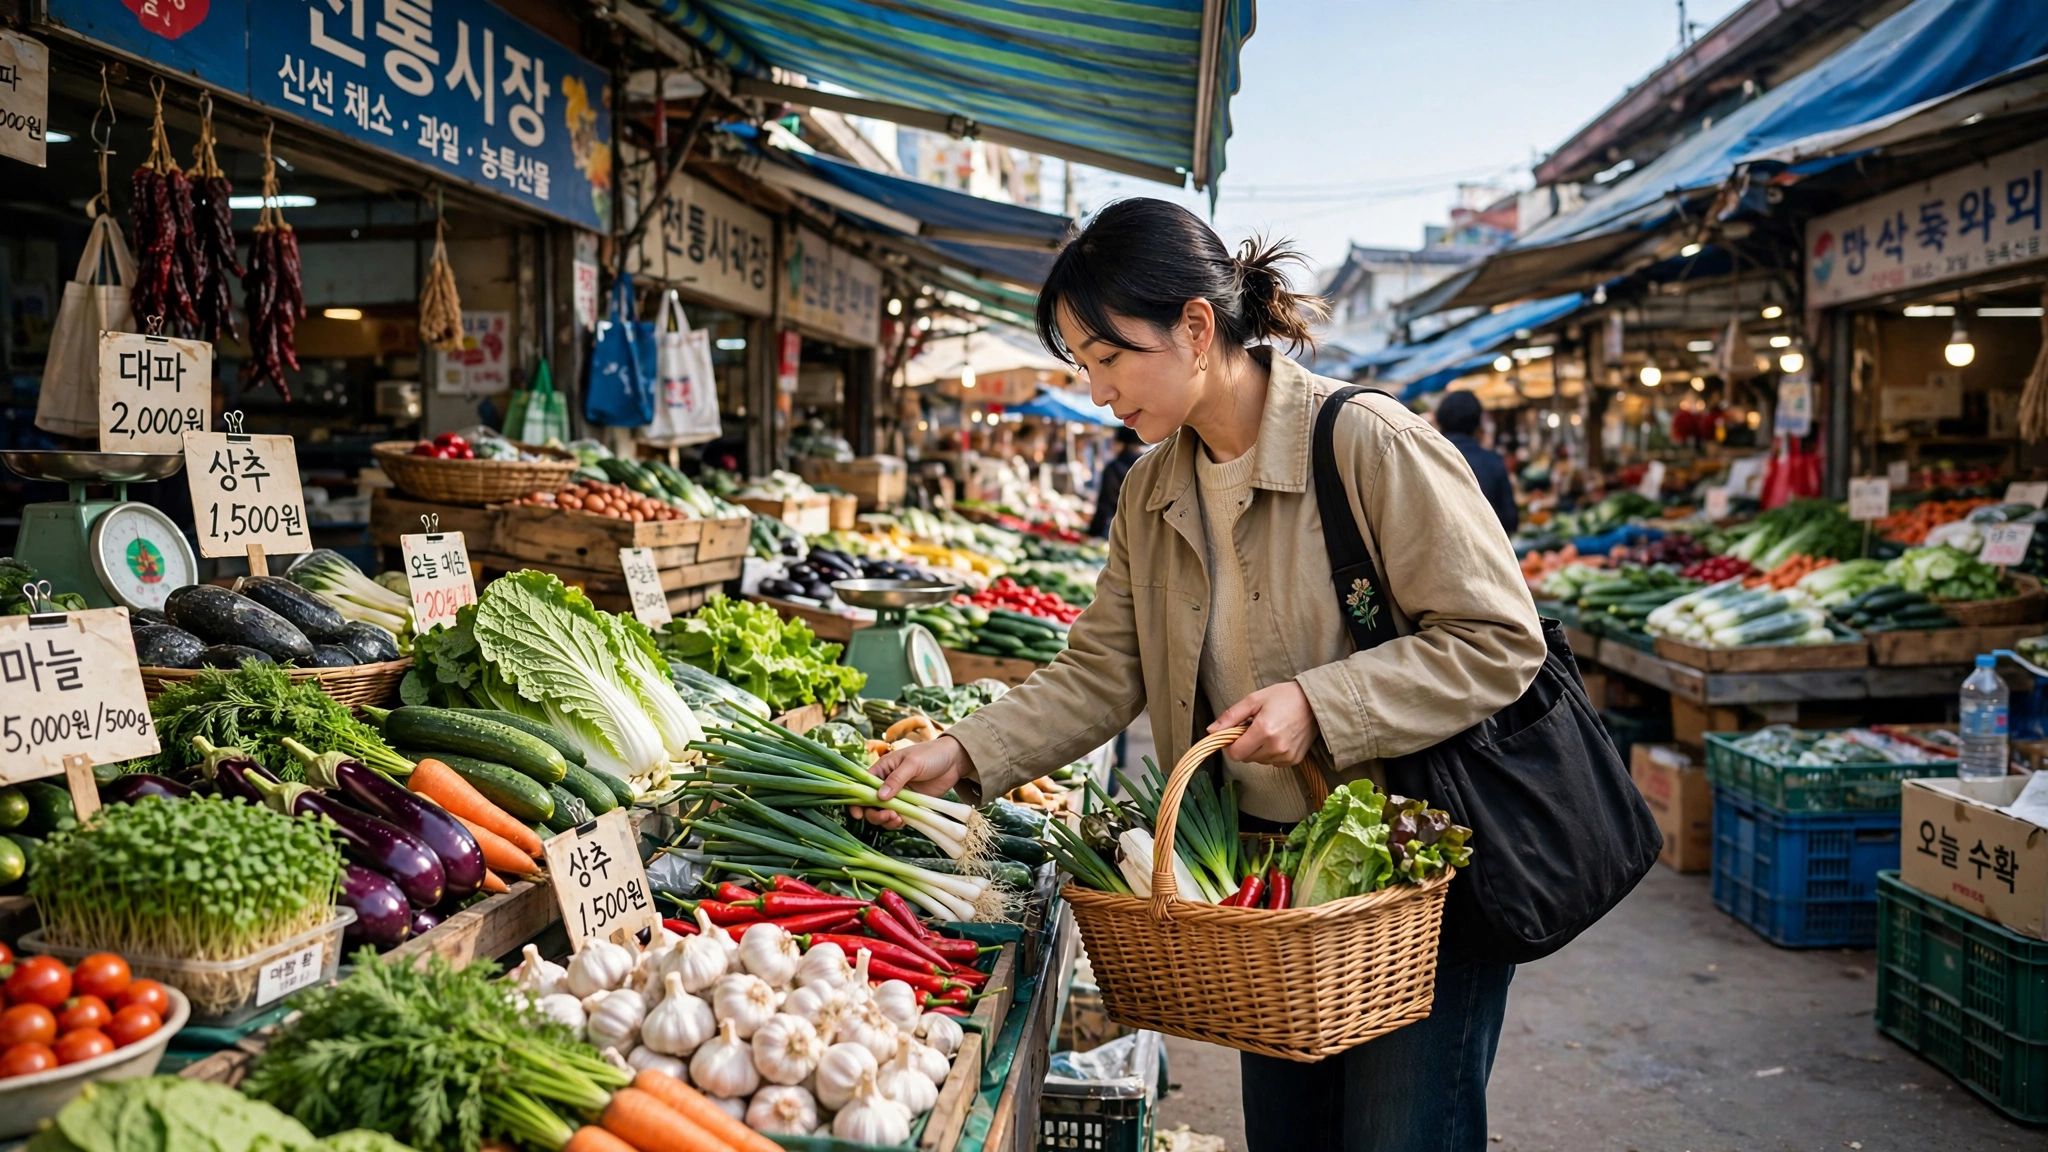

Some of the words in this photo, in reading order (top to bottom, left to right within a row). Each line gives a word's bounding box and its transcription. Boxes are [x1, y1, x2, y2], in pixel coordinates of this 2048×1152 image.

[278, 54, 334, 117] 신선
[344, 81, 393, 136] 채소
[418, 114, 459, 165] 과일
[480, 138, 550, 200] 농특산물
[119, 349, 187, 392] 대파
[109, 401, 204, 440] 2,000원
[208, 448, 271, 493] 상추
[209, 502, 304, 543] 1,500원
[411, 553, 439, 580] 오늘
[1, 639, 84, 692] 마늘
[3, 701, 151, 754] 5,000원/500g
[569, 841, 612, 888] 상추
[1916, 820, 1960, 869] 오늘
[1968, 839, 2020, 895] 수확
[579, 878, 648, 937] 1,500원
